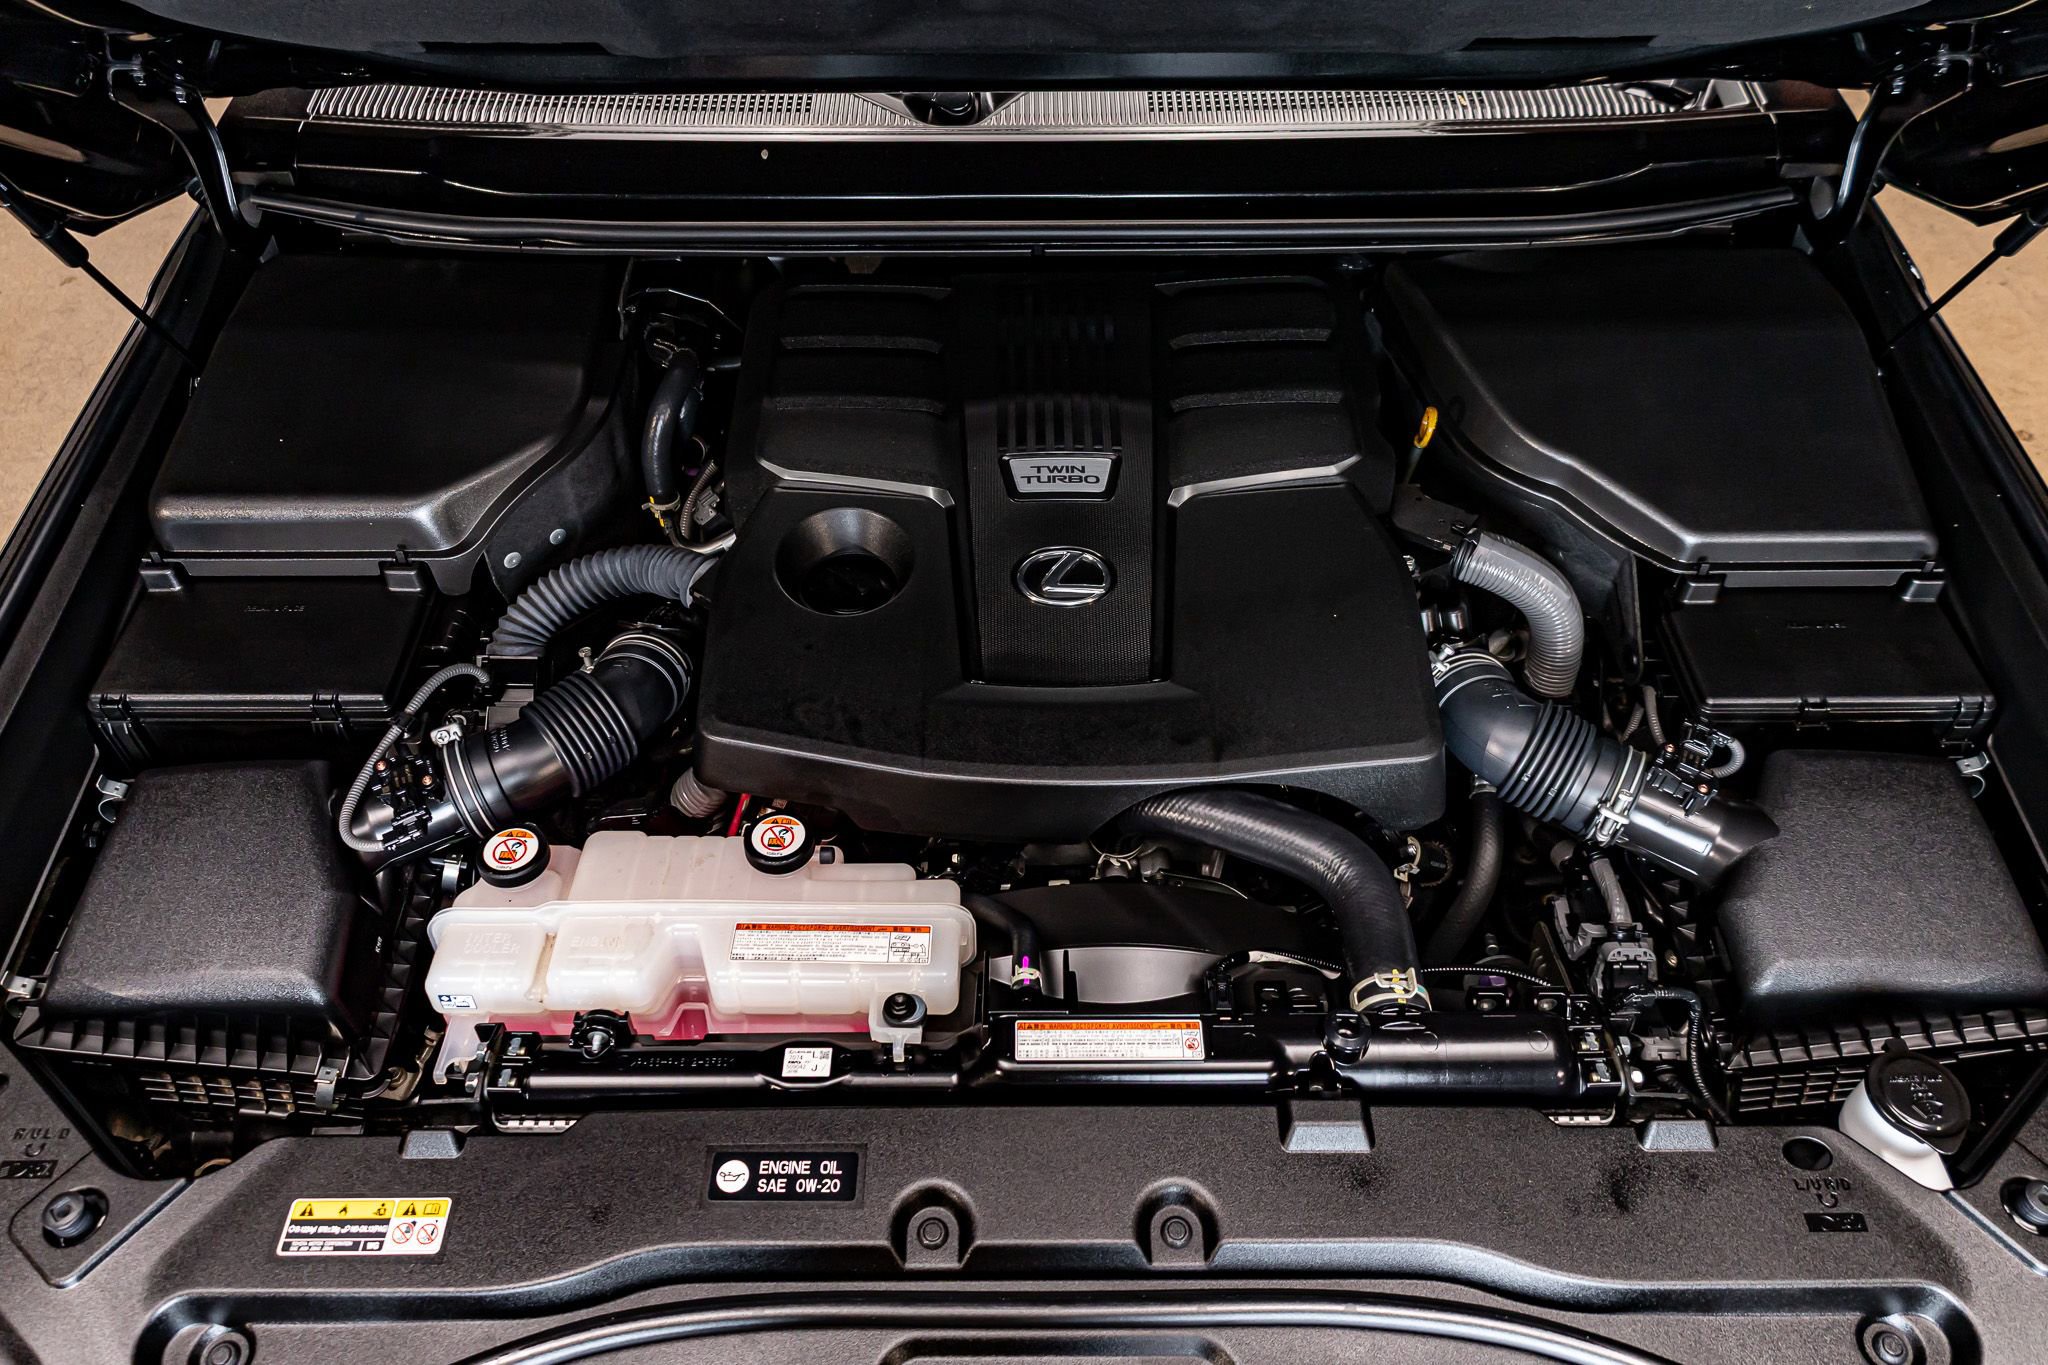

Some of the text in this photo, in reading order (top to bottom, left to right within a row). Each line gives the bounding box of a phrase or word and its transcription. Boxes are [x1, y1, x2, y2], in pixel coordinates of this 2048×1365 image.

[1030, 465, 1086, 474] TWIN
[1020, 474, 1100, 484] TURBO
[758, 1160, 843, 1175] ENGINE OIL
[756, 1178, 841, 1193] SAE 0W-20
